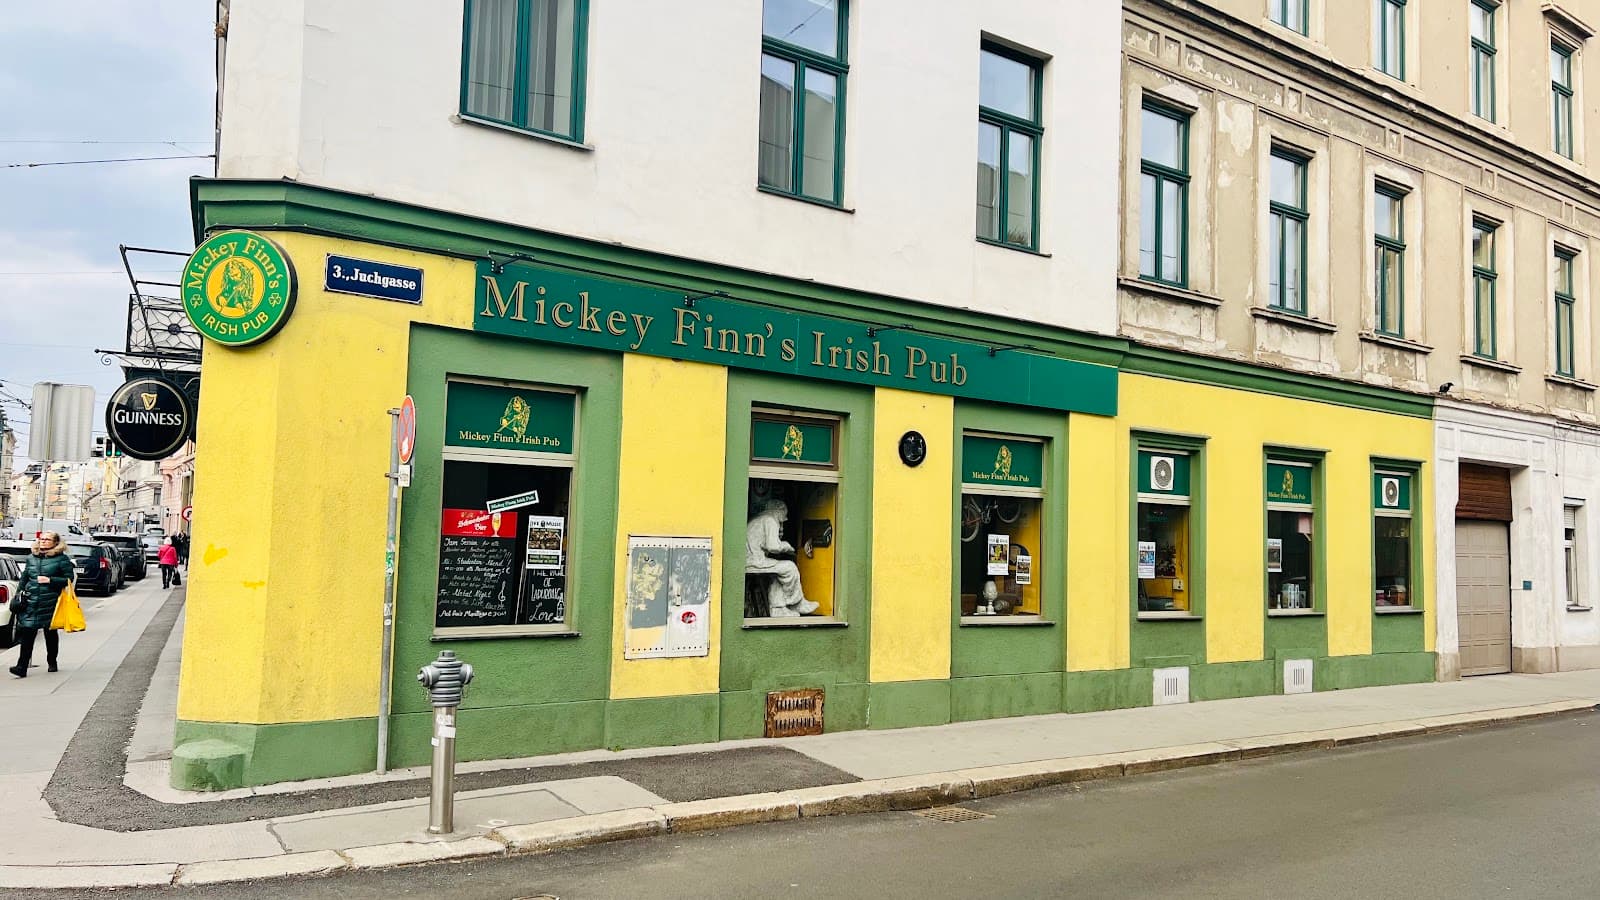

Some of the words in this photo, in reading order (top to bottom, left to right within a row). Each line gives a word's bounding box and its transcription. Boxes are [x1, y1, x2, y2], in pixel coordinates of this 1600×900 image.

[187, 242, 238, 290] Mickey
[201, 313, 238, 336] IRISH
[241, 311, 269, 334] PUB
[480, 275, 654, 350] Mickey
[811, 331, 892, 376] Irish
[904, 345, 967, 386] Pub
[114, 409, 182, 426] GUINNESS
[459, 430, 491, 443] Mickey
[522, 435, 541, 445] Irish
[543, 436, 561, 447] Pub
[972, 471, 990, 480] Mickey
[1019, 474, 1030, 482] Pub
